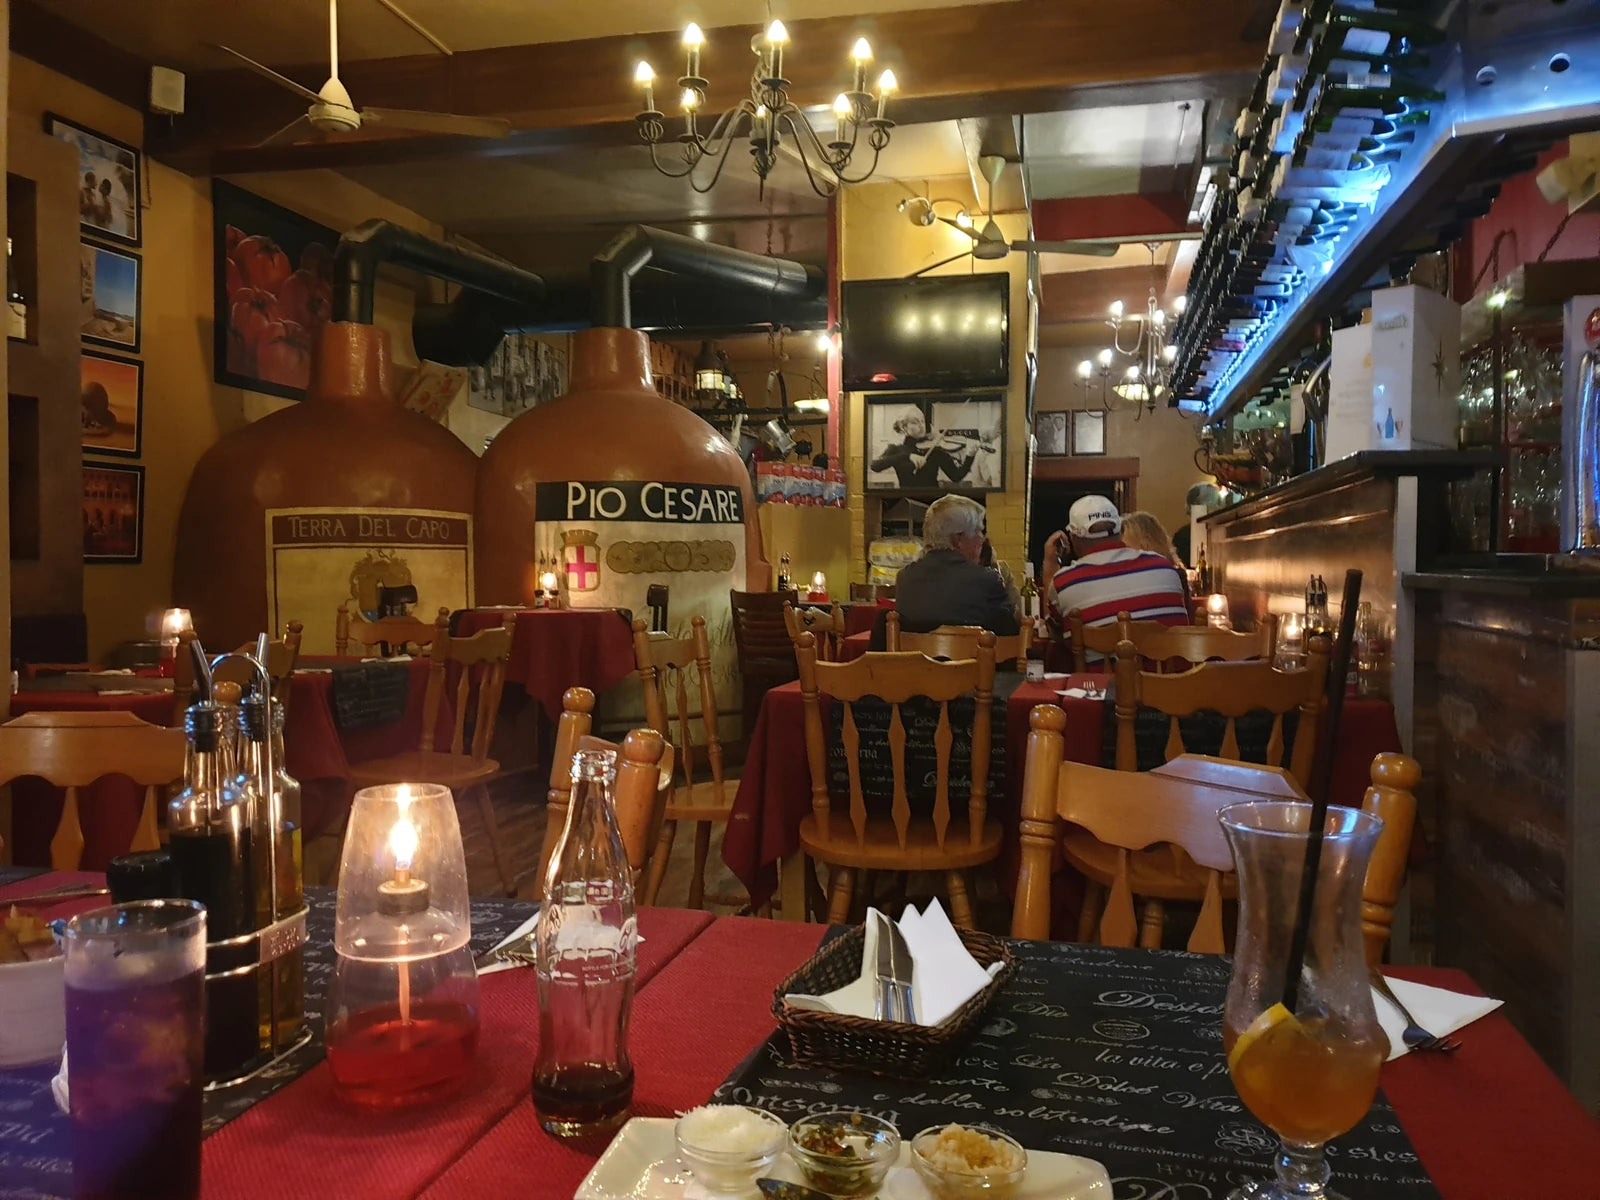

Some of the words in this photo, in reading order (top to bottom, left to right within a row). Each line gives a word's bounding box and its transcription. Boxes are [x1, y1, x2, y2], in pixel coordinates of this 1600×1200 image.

[567, 481, 627, 519] PIO
[640, 482, 740, 521] CESARE
[288, 516, 346, 538] TERRA
[358, 515, 395, 537] DEL
[406, 517, 450, 539] CAPO
[1088, 511, 1112, 521] PING
